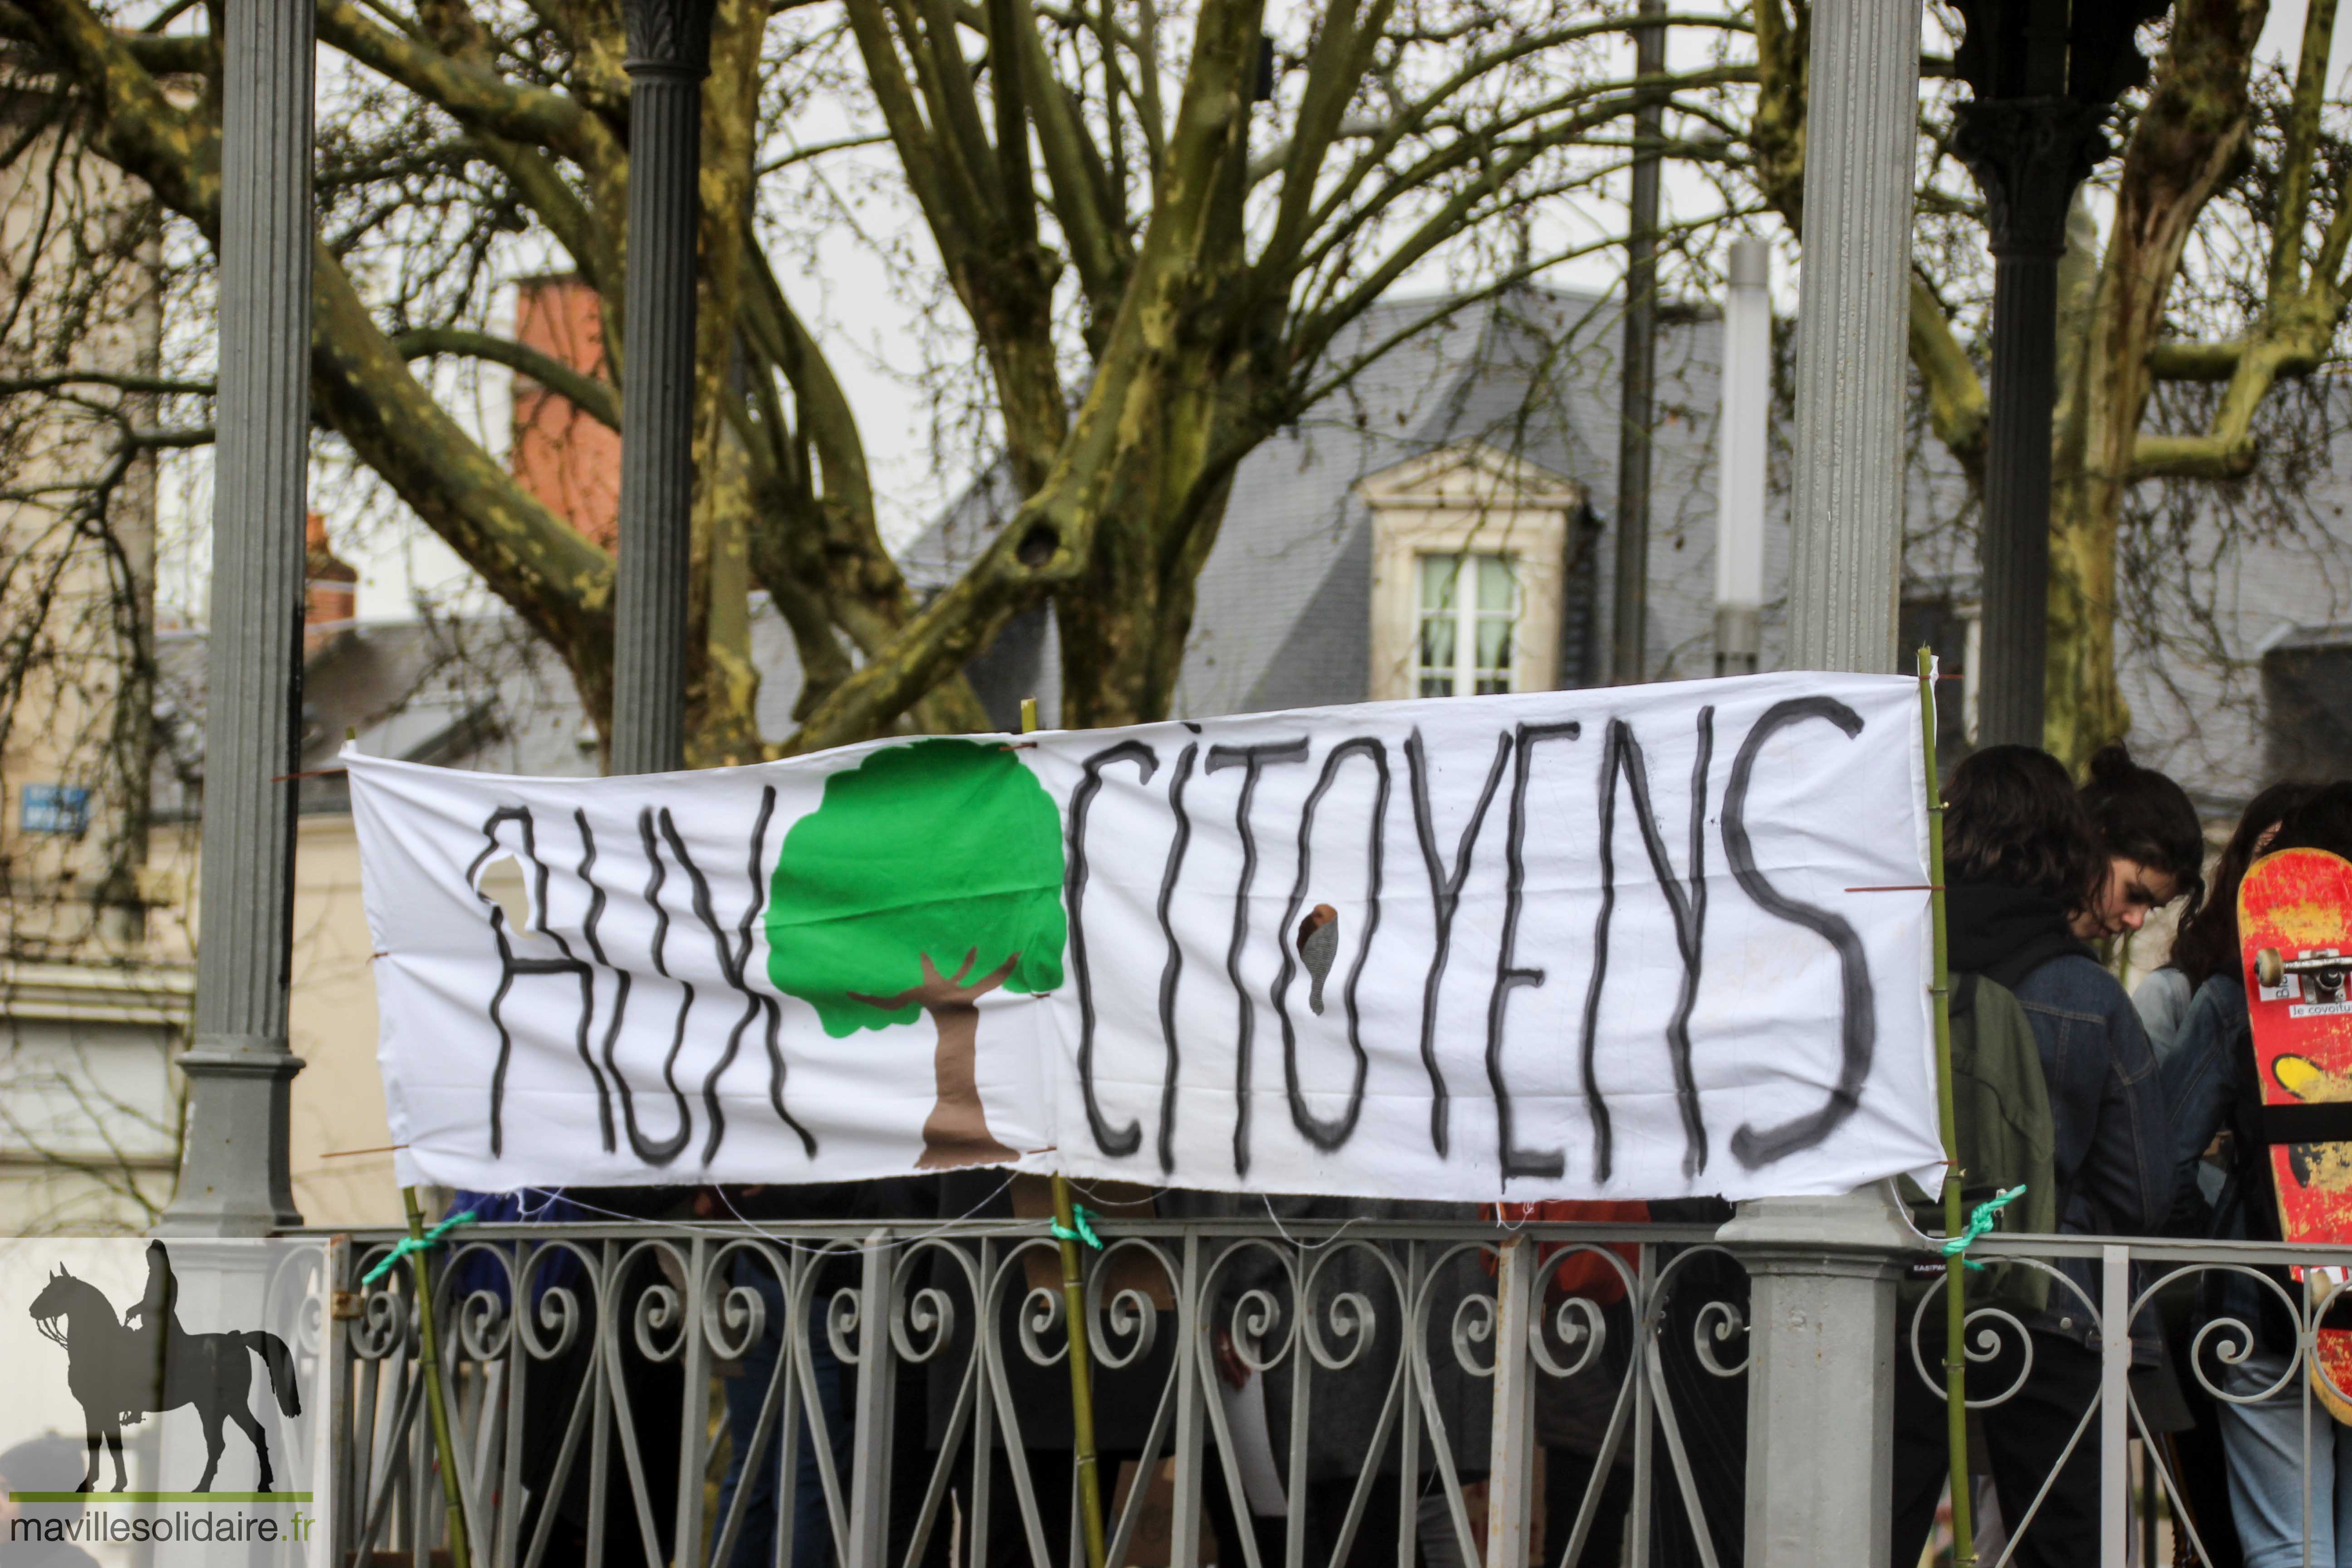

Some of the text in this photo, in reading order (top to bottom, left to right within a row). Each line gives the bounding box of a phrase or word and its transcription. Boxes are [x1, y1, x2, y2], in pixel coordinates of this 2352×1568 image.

[467, 696, 1874, 1192] AUX CITOYENS
[2308, 1001, 2352, 1014] covoitu
